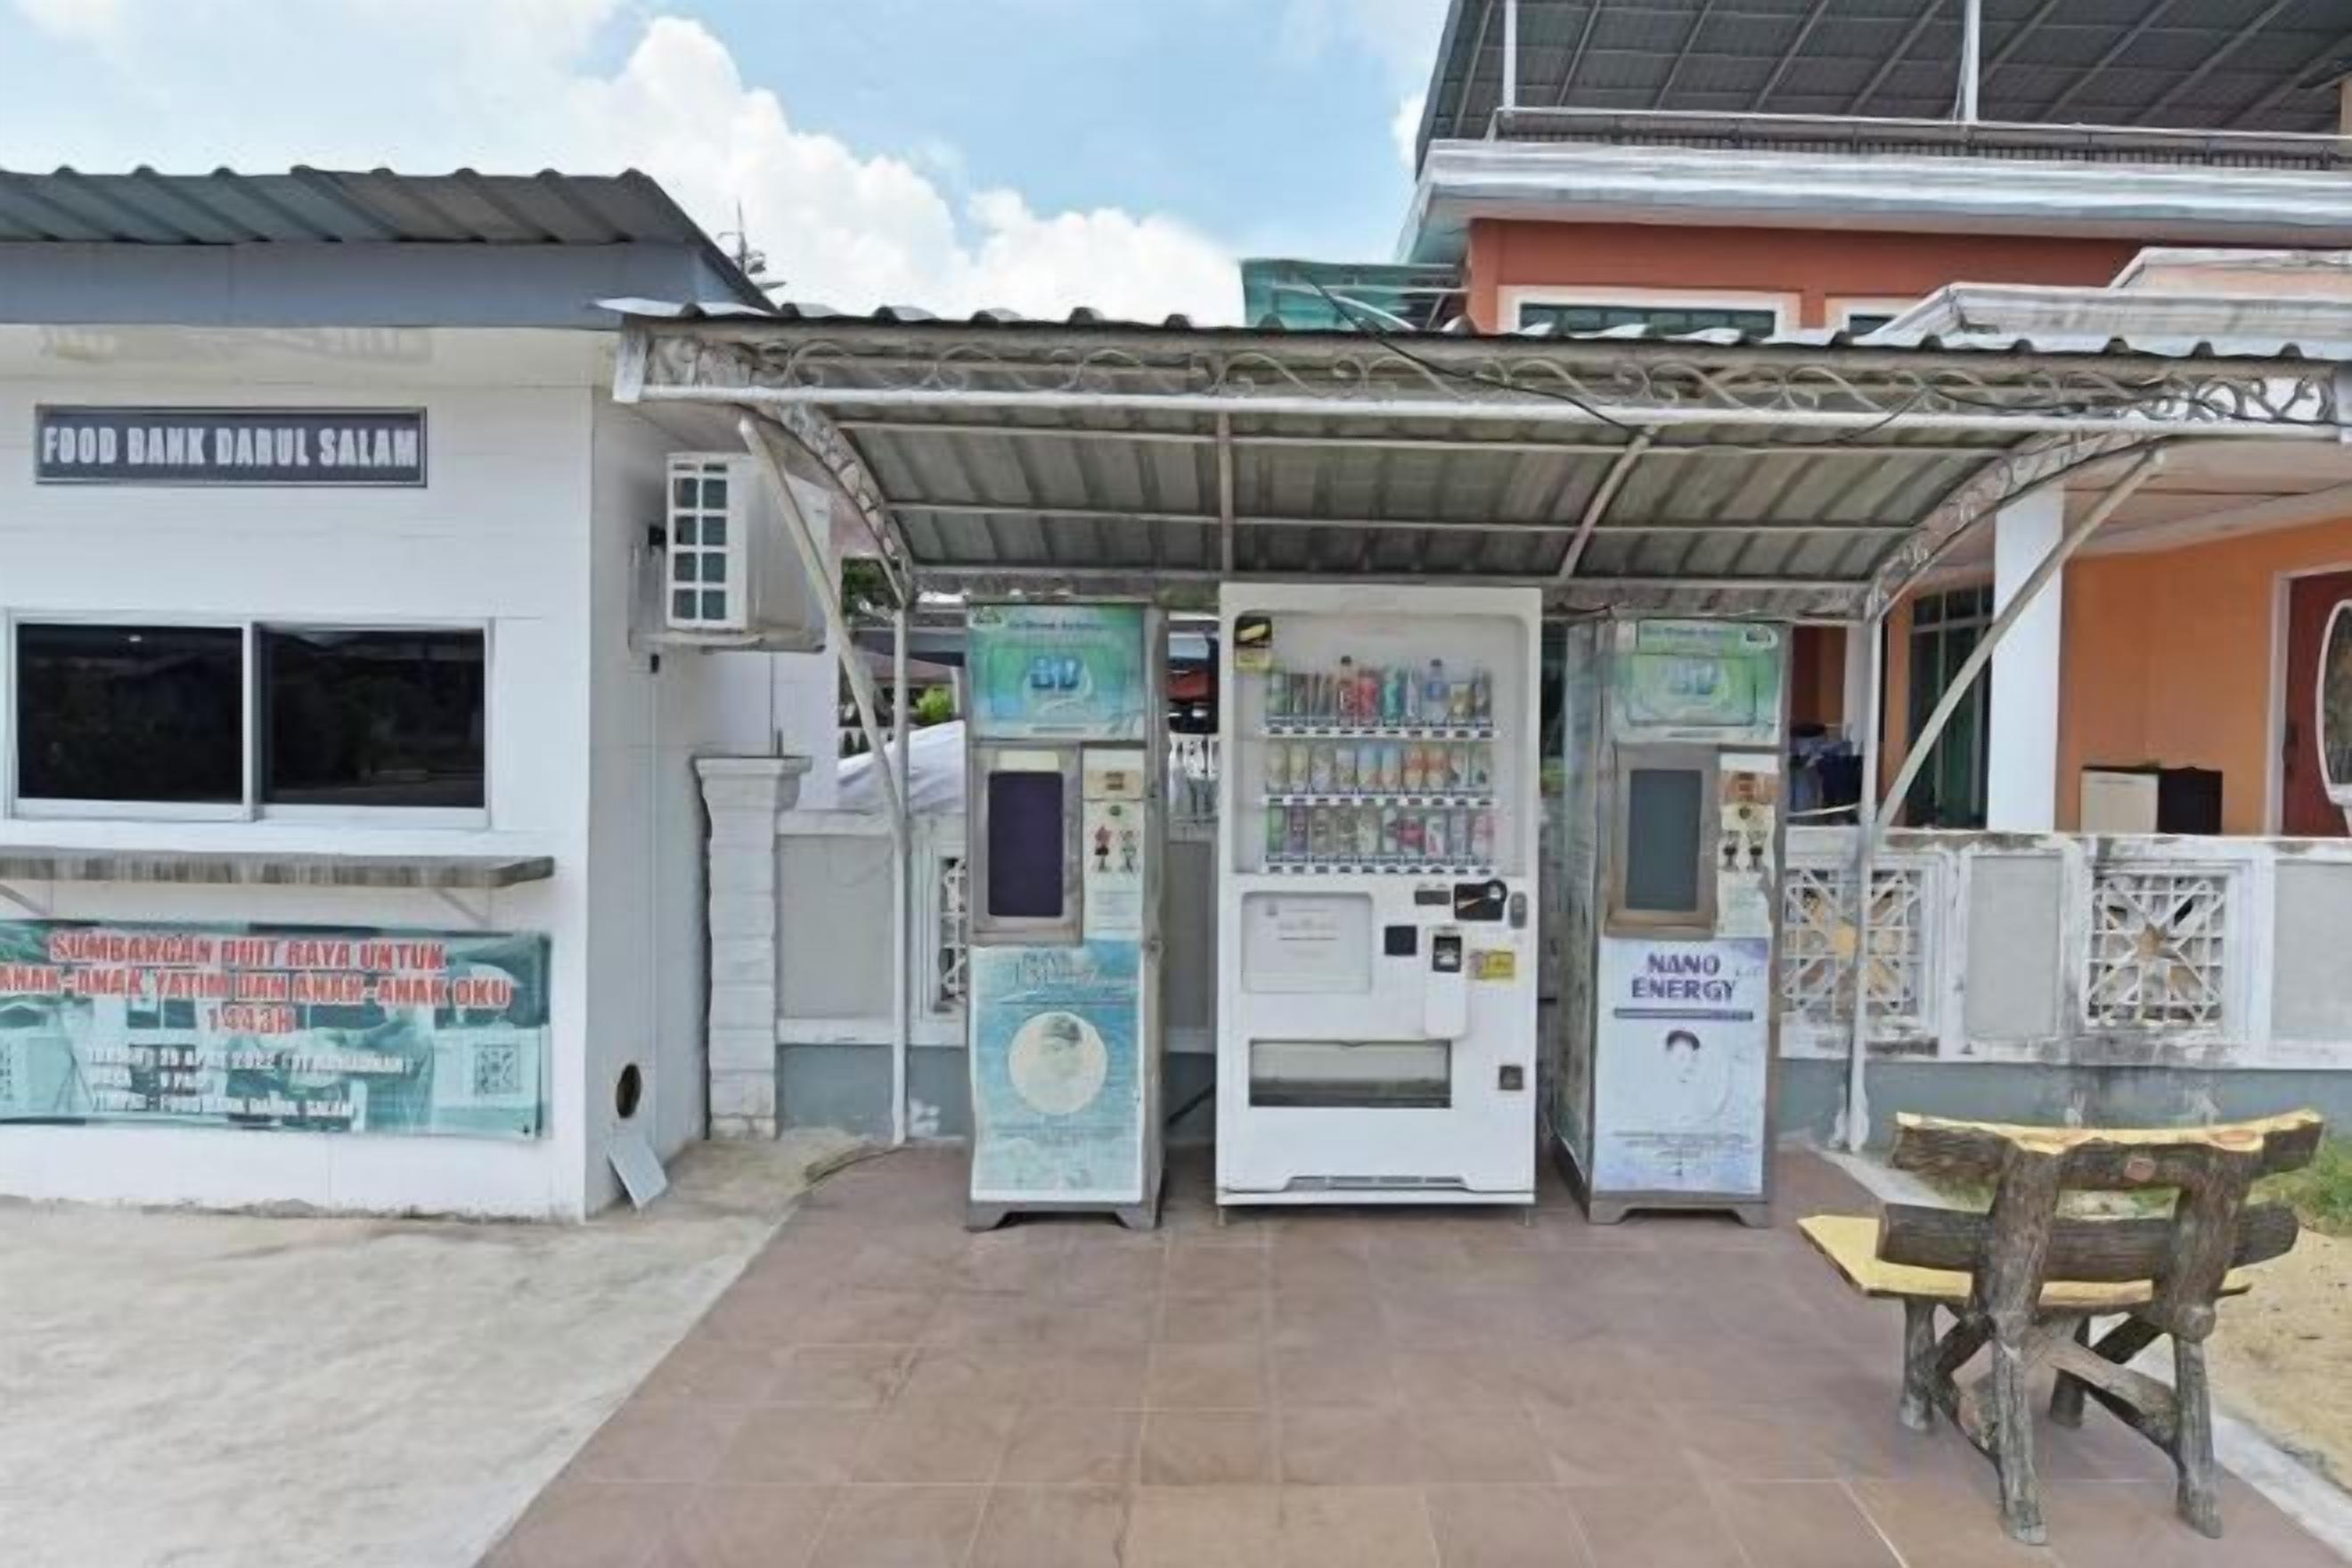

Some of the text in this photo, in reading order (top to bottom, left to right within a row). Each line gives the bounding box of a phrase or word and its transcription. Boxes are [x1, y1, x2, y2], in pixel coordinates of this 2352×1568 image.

[43, 427, 418, 468] FOOD BANK DARUL SALAM
[51, 932, 212, 965] SUMBANGAN
[285, 940, 350, 969] RAYA
[359, 941, 445, 971] UNTUK
[1648, 953, 1721, 976] NANO
[234, 969, 288, 1002] DAN
[454, 976, 512, 1009] OKU
[1632, 977, 1736, 1001] ENERGY
